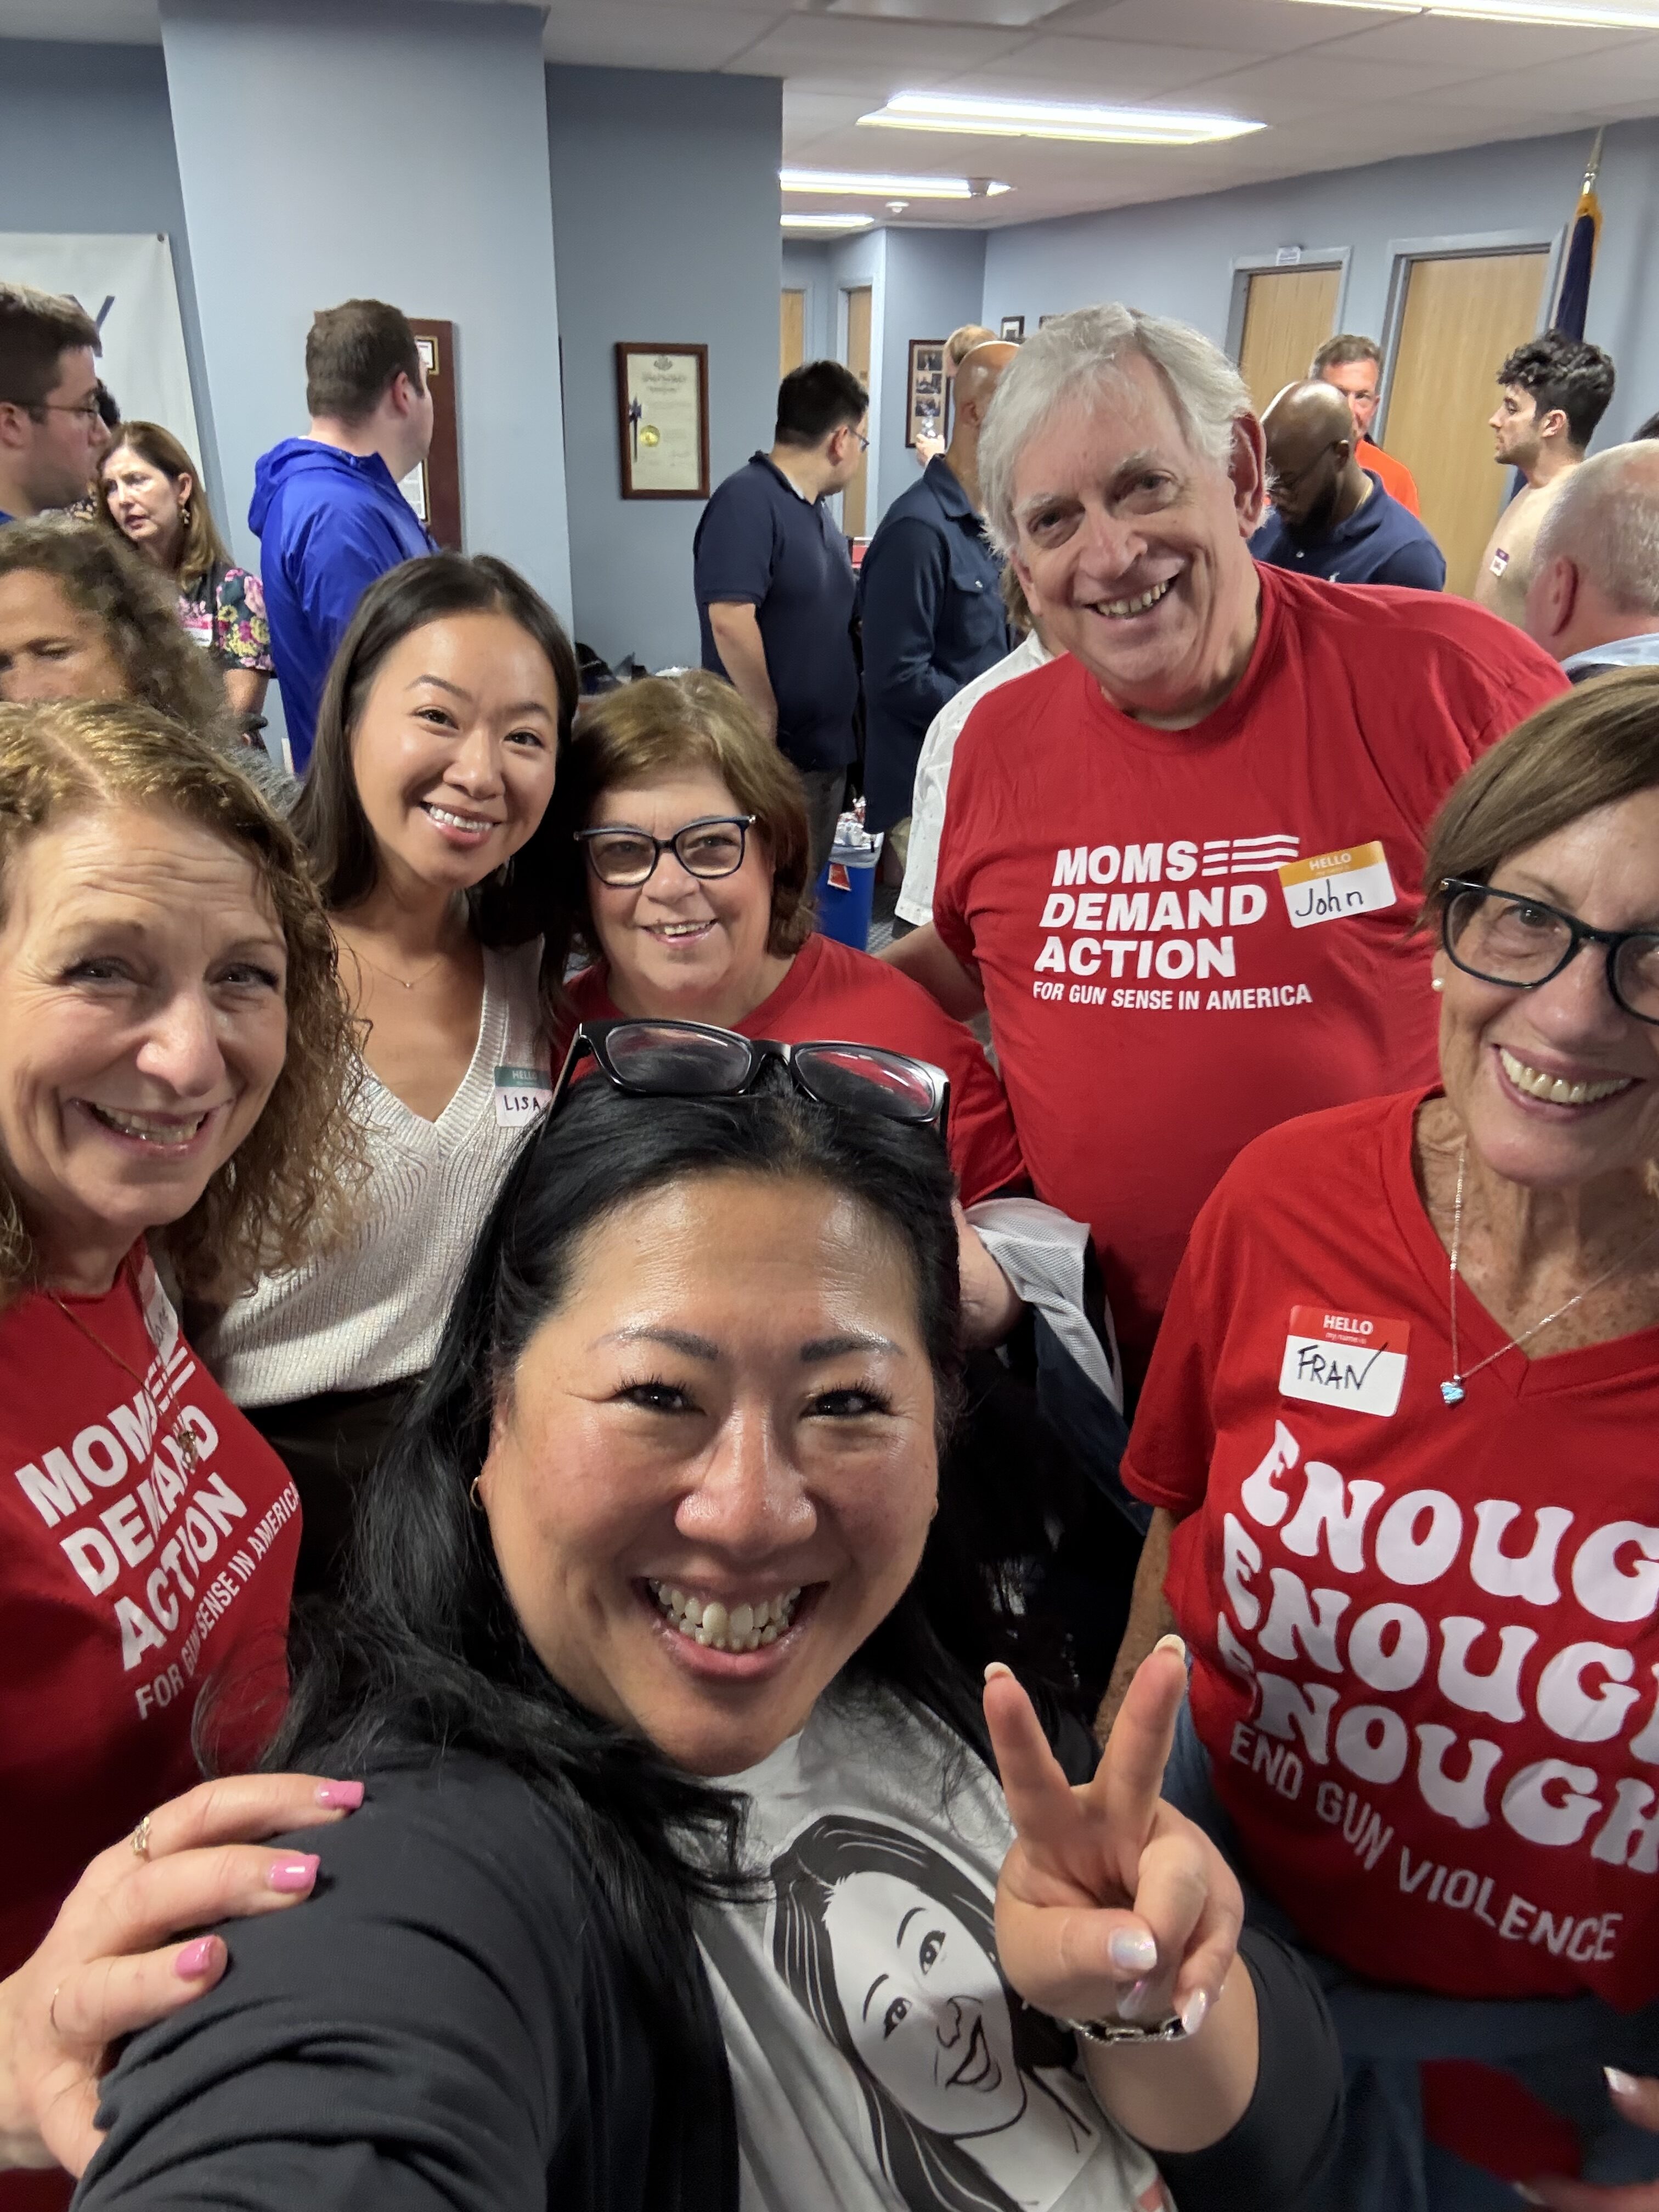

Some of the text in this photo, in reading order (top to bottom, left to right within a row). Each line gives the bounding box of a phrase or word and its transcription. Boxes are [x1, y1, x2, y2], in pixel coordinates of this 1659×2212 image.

[1052, 841, 1198, 887] MOMS
[1309, 853, 1352, 871] HELLO
[1039, 884, 1268, 932] DEMAND
[1295, 878, 1364, 917] John
[1034, 936, 1236, 979] ACTION
[1032, 981, 1313, 1011] FOR GUN SENSE IN AMERICA
[504, 1094, 541, 1111] LISA
[1323, 1314, 1374, 1335] HELLO
[1297, 1342, 1389, 1390] FRAN
[114, 1472, 247, 1672] ACTION
[135, 1663, 184, 1720] FOR
[195, 1571, 240, 1640] SENSE
[228, 1549, 256, 1583] IN
[1229, 1721, 1624, 1962] END GUN VIOLENCE
